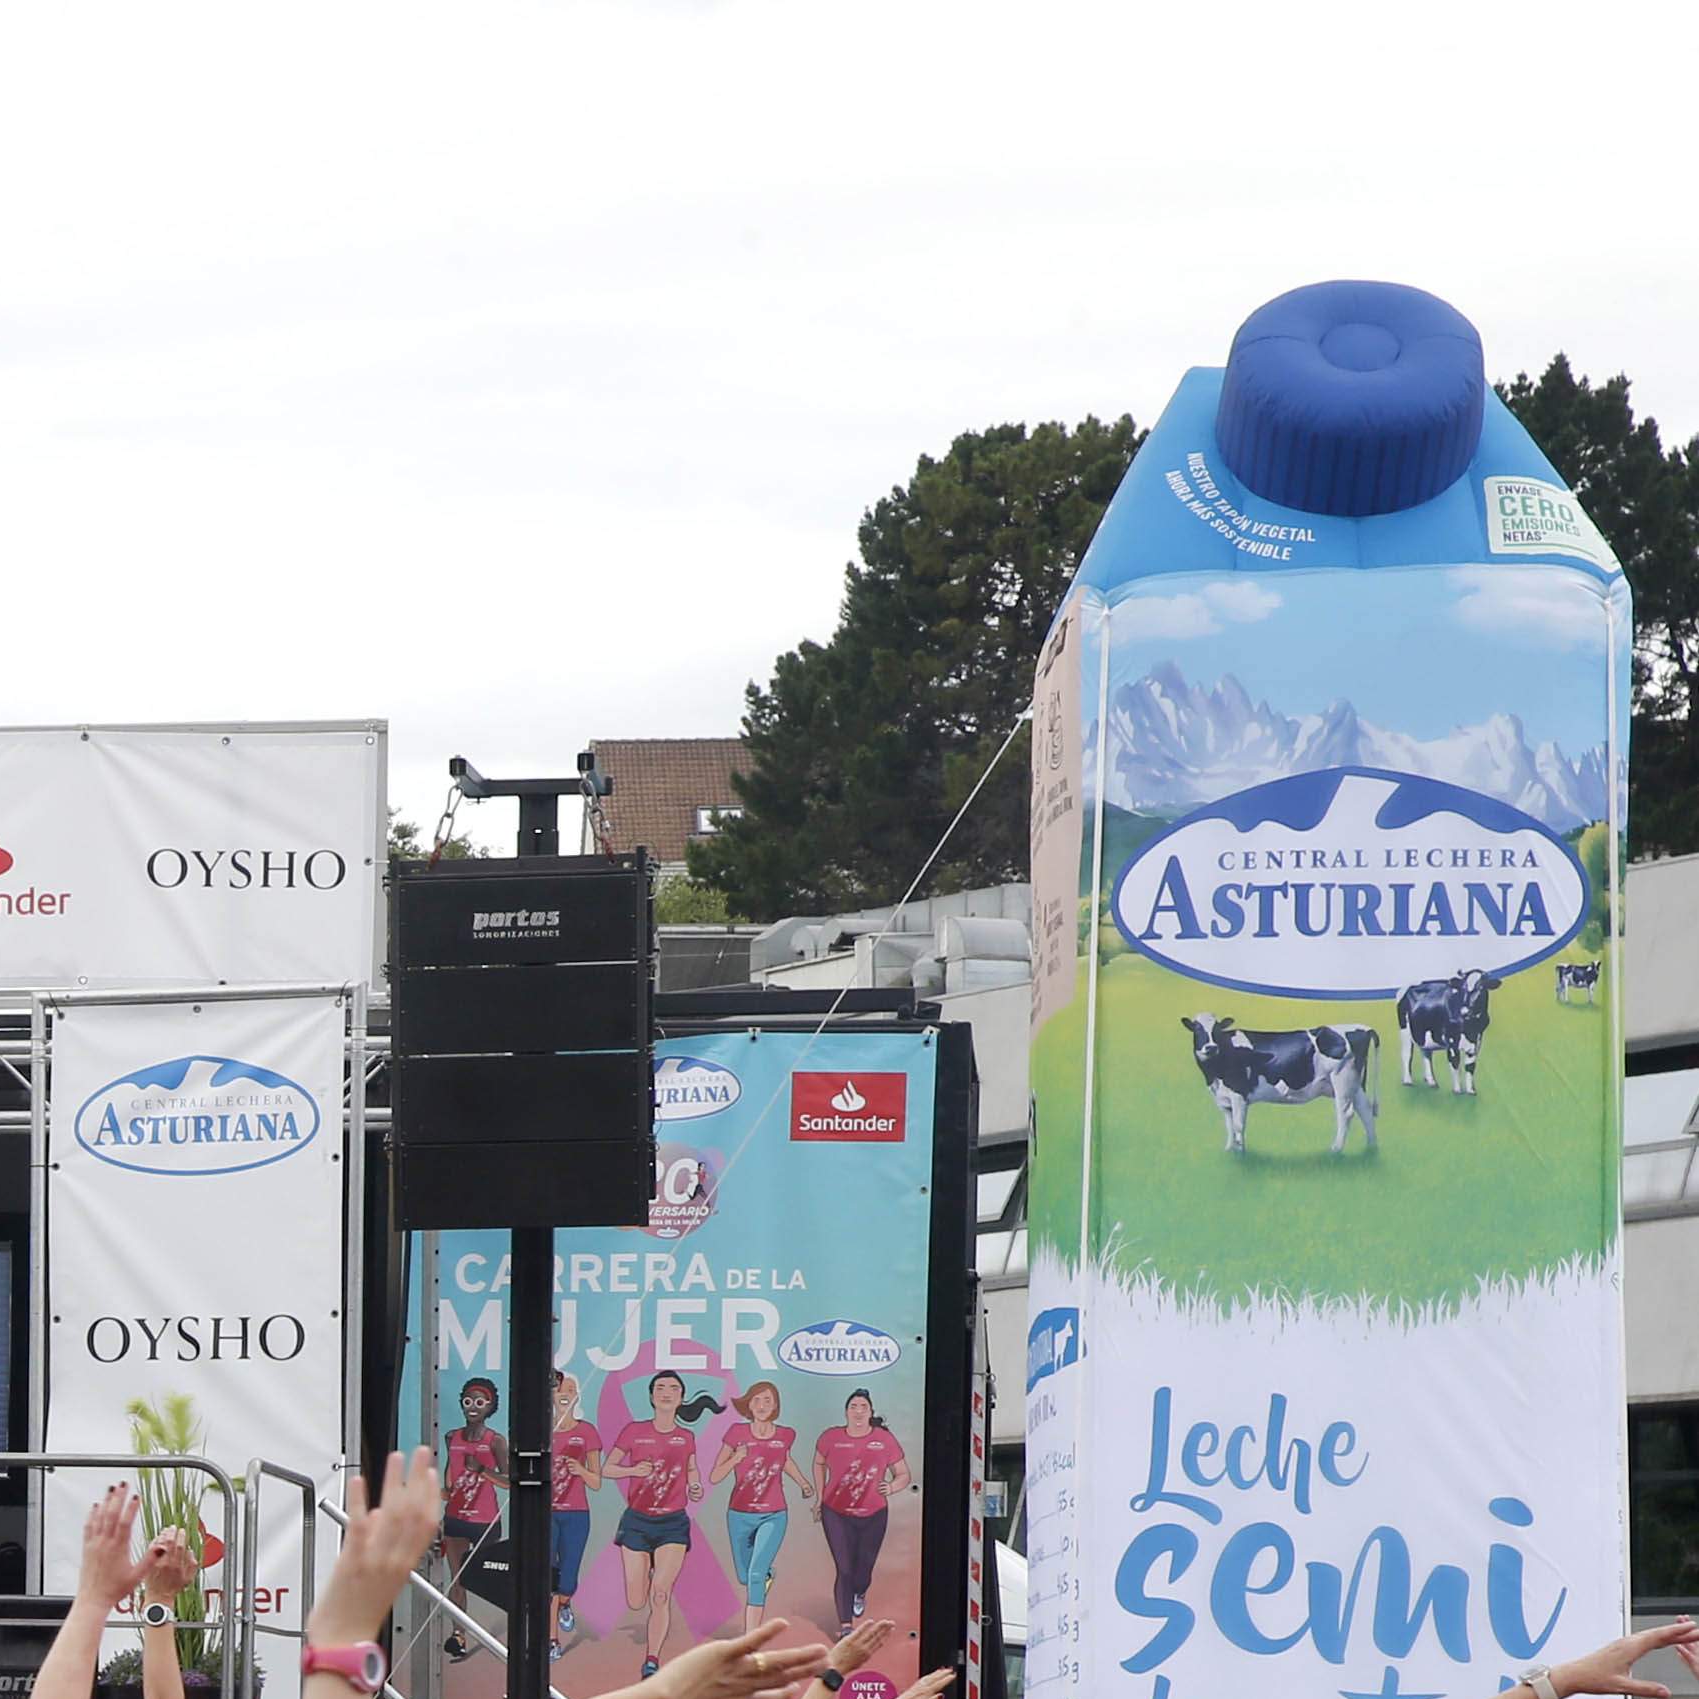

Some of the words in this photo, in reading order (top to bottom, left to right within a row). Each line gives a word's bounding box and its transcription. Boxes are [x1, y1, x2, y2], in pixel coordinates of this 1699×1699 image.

[1187, 451, 1220, 499] NUESTRO
[1213, 497, 1252, 532] TAPÓN
[1250, 520, 1316, 542] VEGETAL
[1497, 485, 1542, 496] ENVASE
[1164, 469, 1195, 503] AHORA
[1186, 499, 1216, 521] MÁS
[1209, 518, 1293, 561] SOSTENIBLE
[1498, 495, 1575, 523] CERO
[1501, 518, 1582, 537] EMISIONES
[146, 848, 347, 890] OYSHO
[1218, 849, 1368, 871] CENTRAL
[1384, 848, 1541, 869] LECHERA
[1139, 855, 1556, 940] ASTURIANA
[130, 1097, 206, 1111] CENTRAL
[214, 1093, 295, 1108] LECHERA
[94, 1100, 302, 1146] ASTURIANA
[799, 1114, 897, 1132] Santander
[727, 1269, 762, 1291] DE
[769, 1269, 806, 1291] LA
[86, 1314, 306, 1363] OYSHO
[785, 1339, 893, 1365] ASTURIANA
[1129, 1385, 1369, 1525] Leche
[1114, 1496, 1568, 1675] semi
[851, 1680, 887, 1692] ÚNETE
